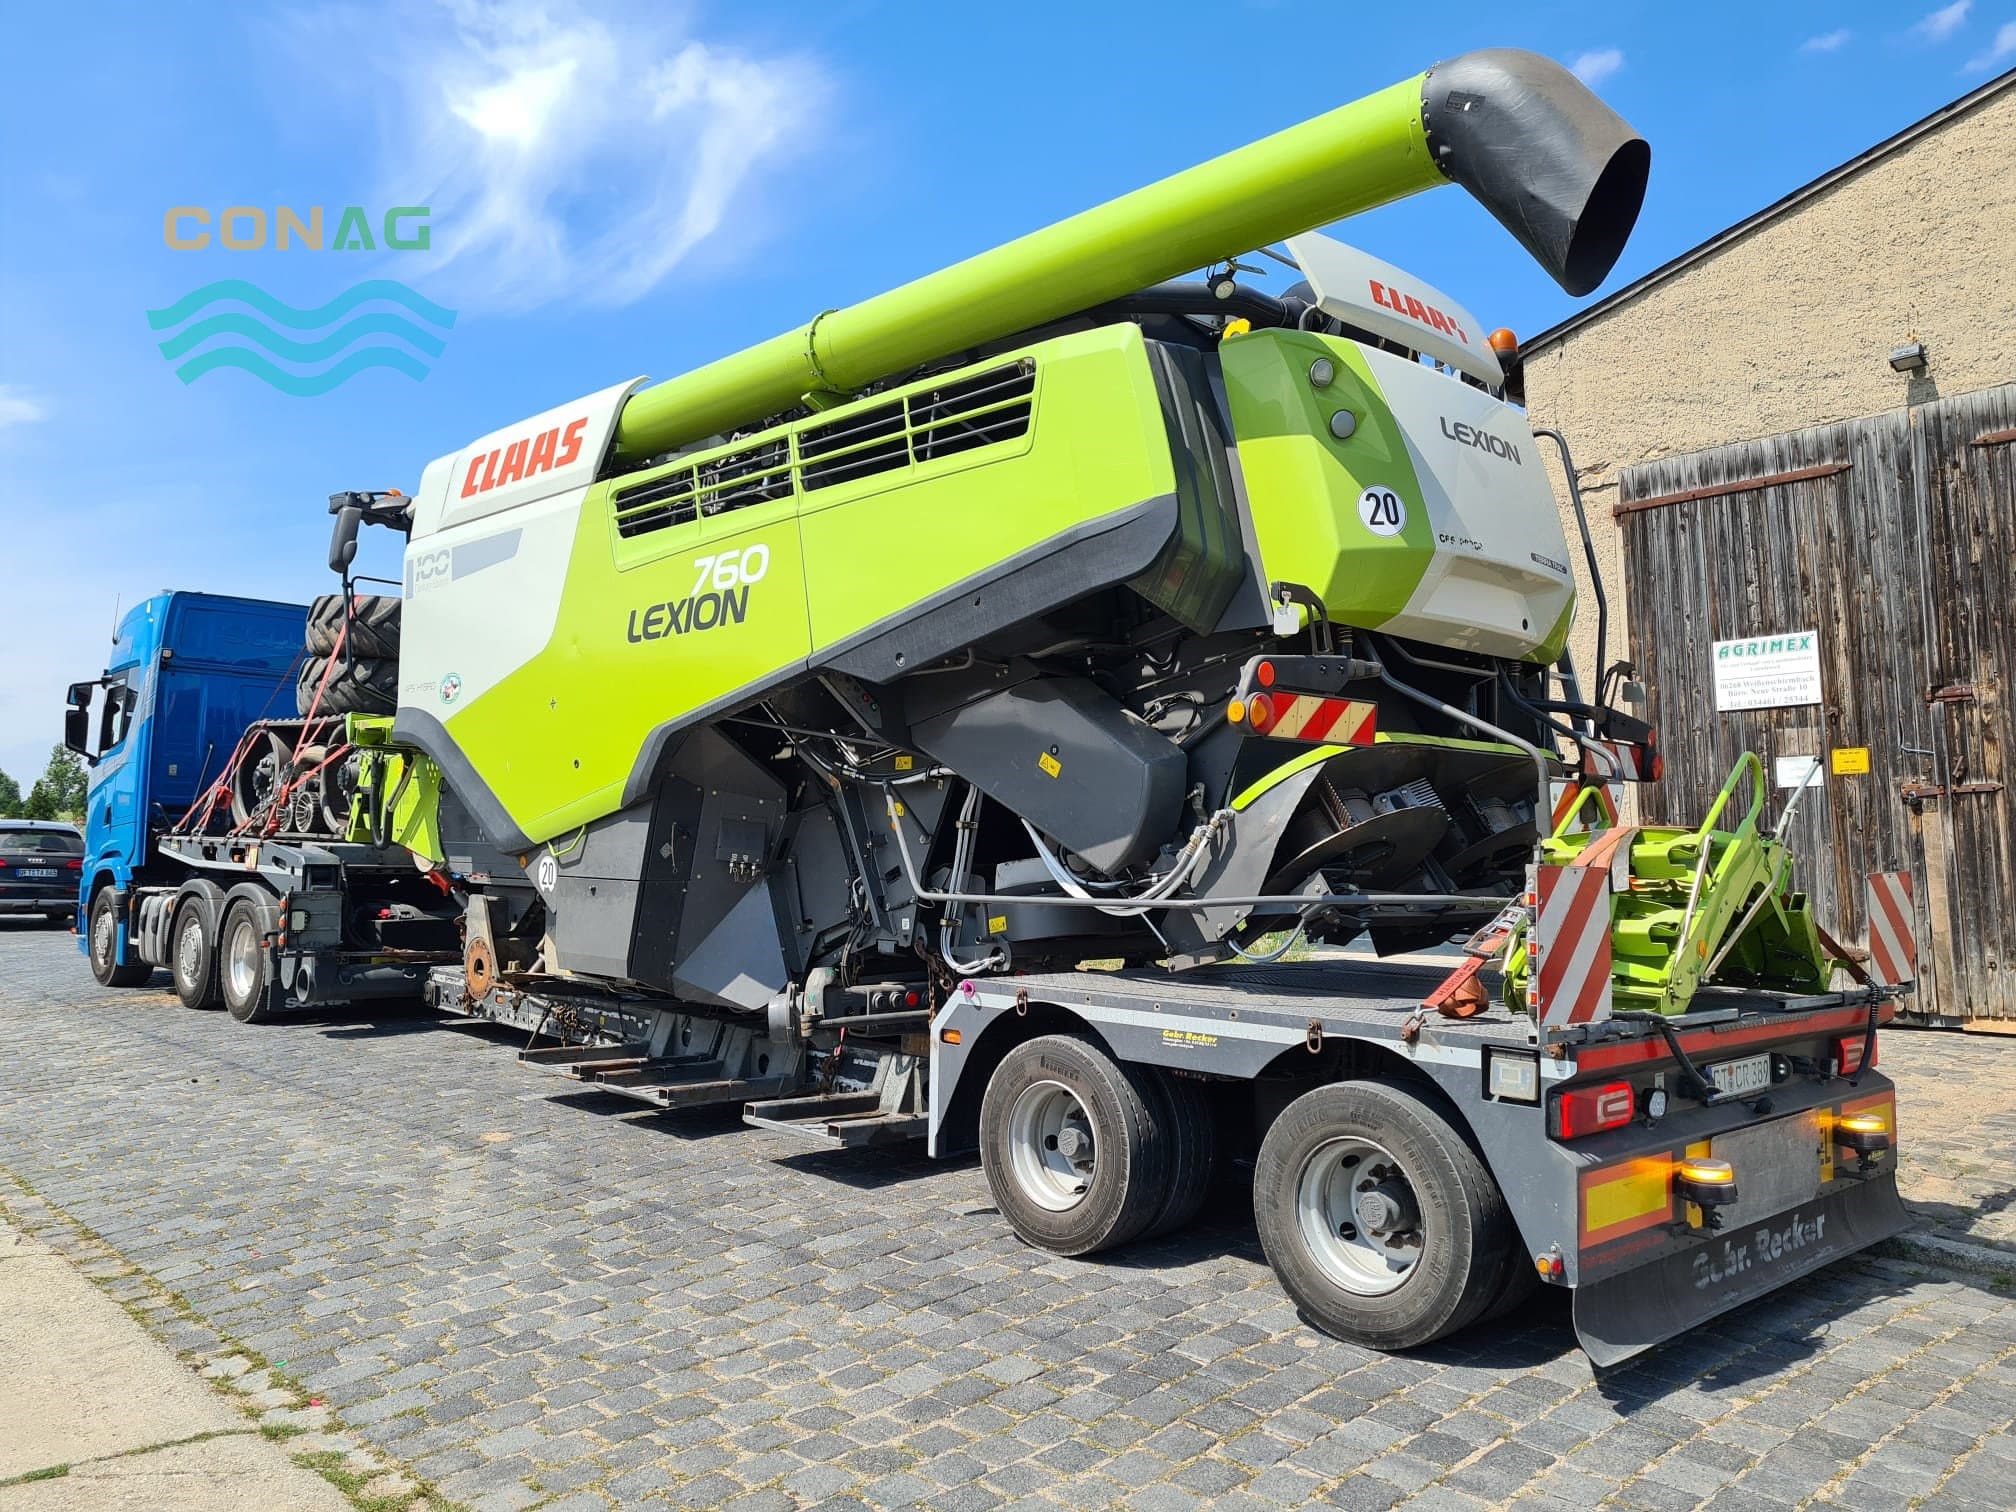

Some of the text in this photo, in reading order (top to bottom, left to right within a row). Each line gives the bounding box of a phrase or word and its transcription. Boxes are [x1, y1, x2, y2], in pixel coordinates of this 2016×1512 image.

[1369, 279, 1468, 345] CLAAS
[460, 416, 588, 499] CLAAS
[1440, 416, 1522, 465] LEXION
[1365, 492, 1400, 526] 20
[415, 548, 450, 582] 100
[690, 543, 770, 596] 760
[627, 585, 750, 643] LEXION
[1718, 636, 1811, 659] AGRIMEX
[541, 861, 554, 885] 20
[1752, 1060, 1769, 1086] 389
[1755, 1213, 1825, 1263] Recker
